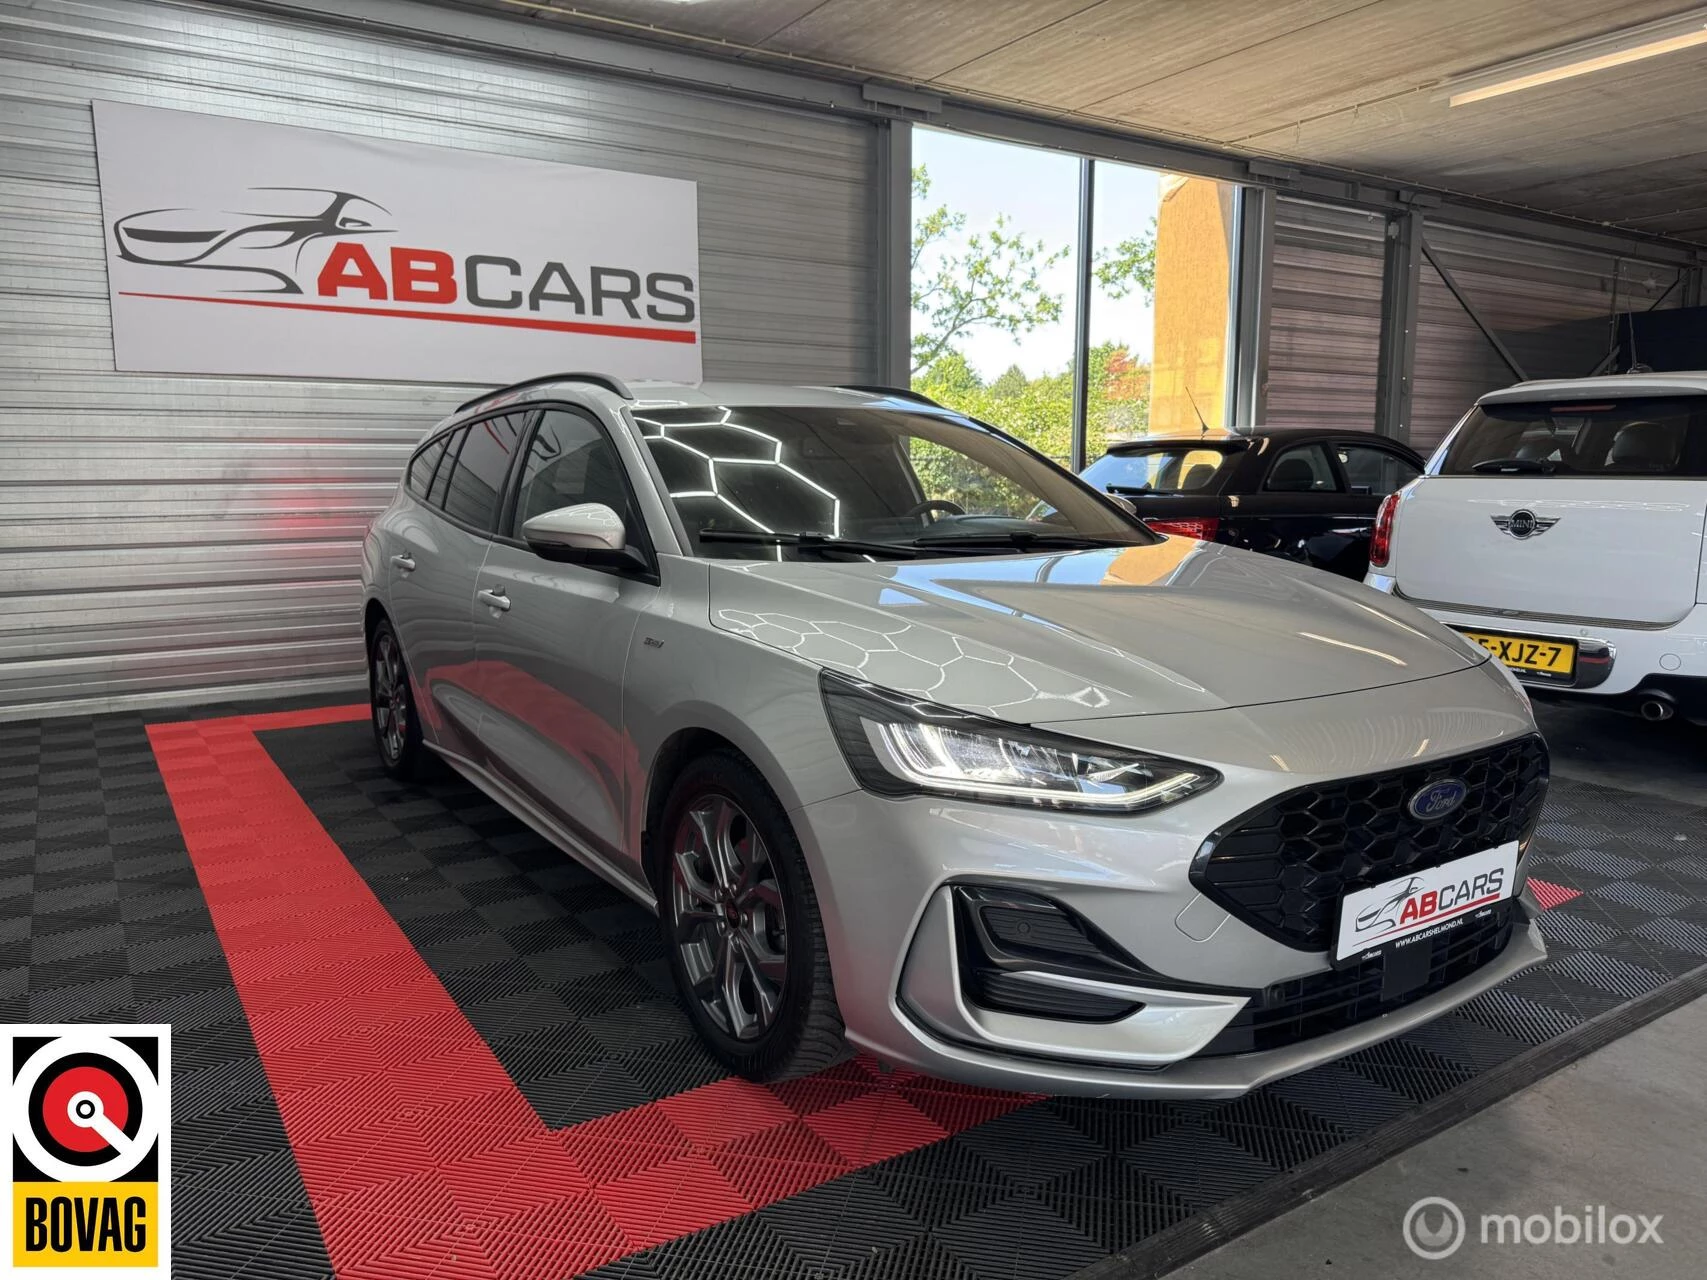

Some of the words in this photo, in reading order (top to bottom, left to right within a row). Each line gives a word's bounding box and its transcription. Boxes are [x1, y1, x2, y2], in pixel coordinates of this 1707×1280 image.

[317, 242, 695, 323] ABCARS
[1509, 519, 1534, 529] MINI
[1426, 790, 1457, 812] Ford
[1400, 867, 1504, 924] ABCARS
[1395, 917, 1464, 949] WWW.ABCARSHELMOND.NL
